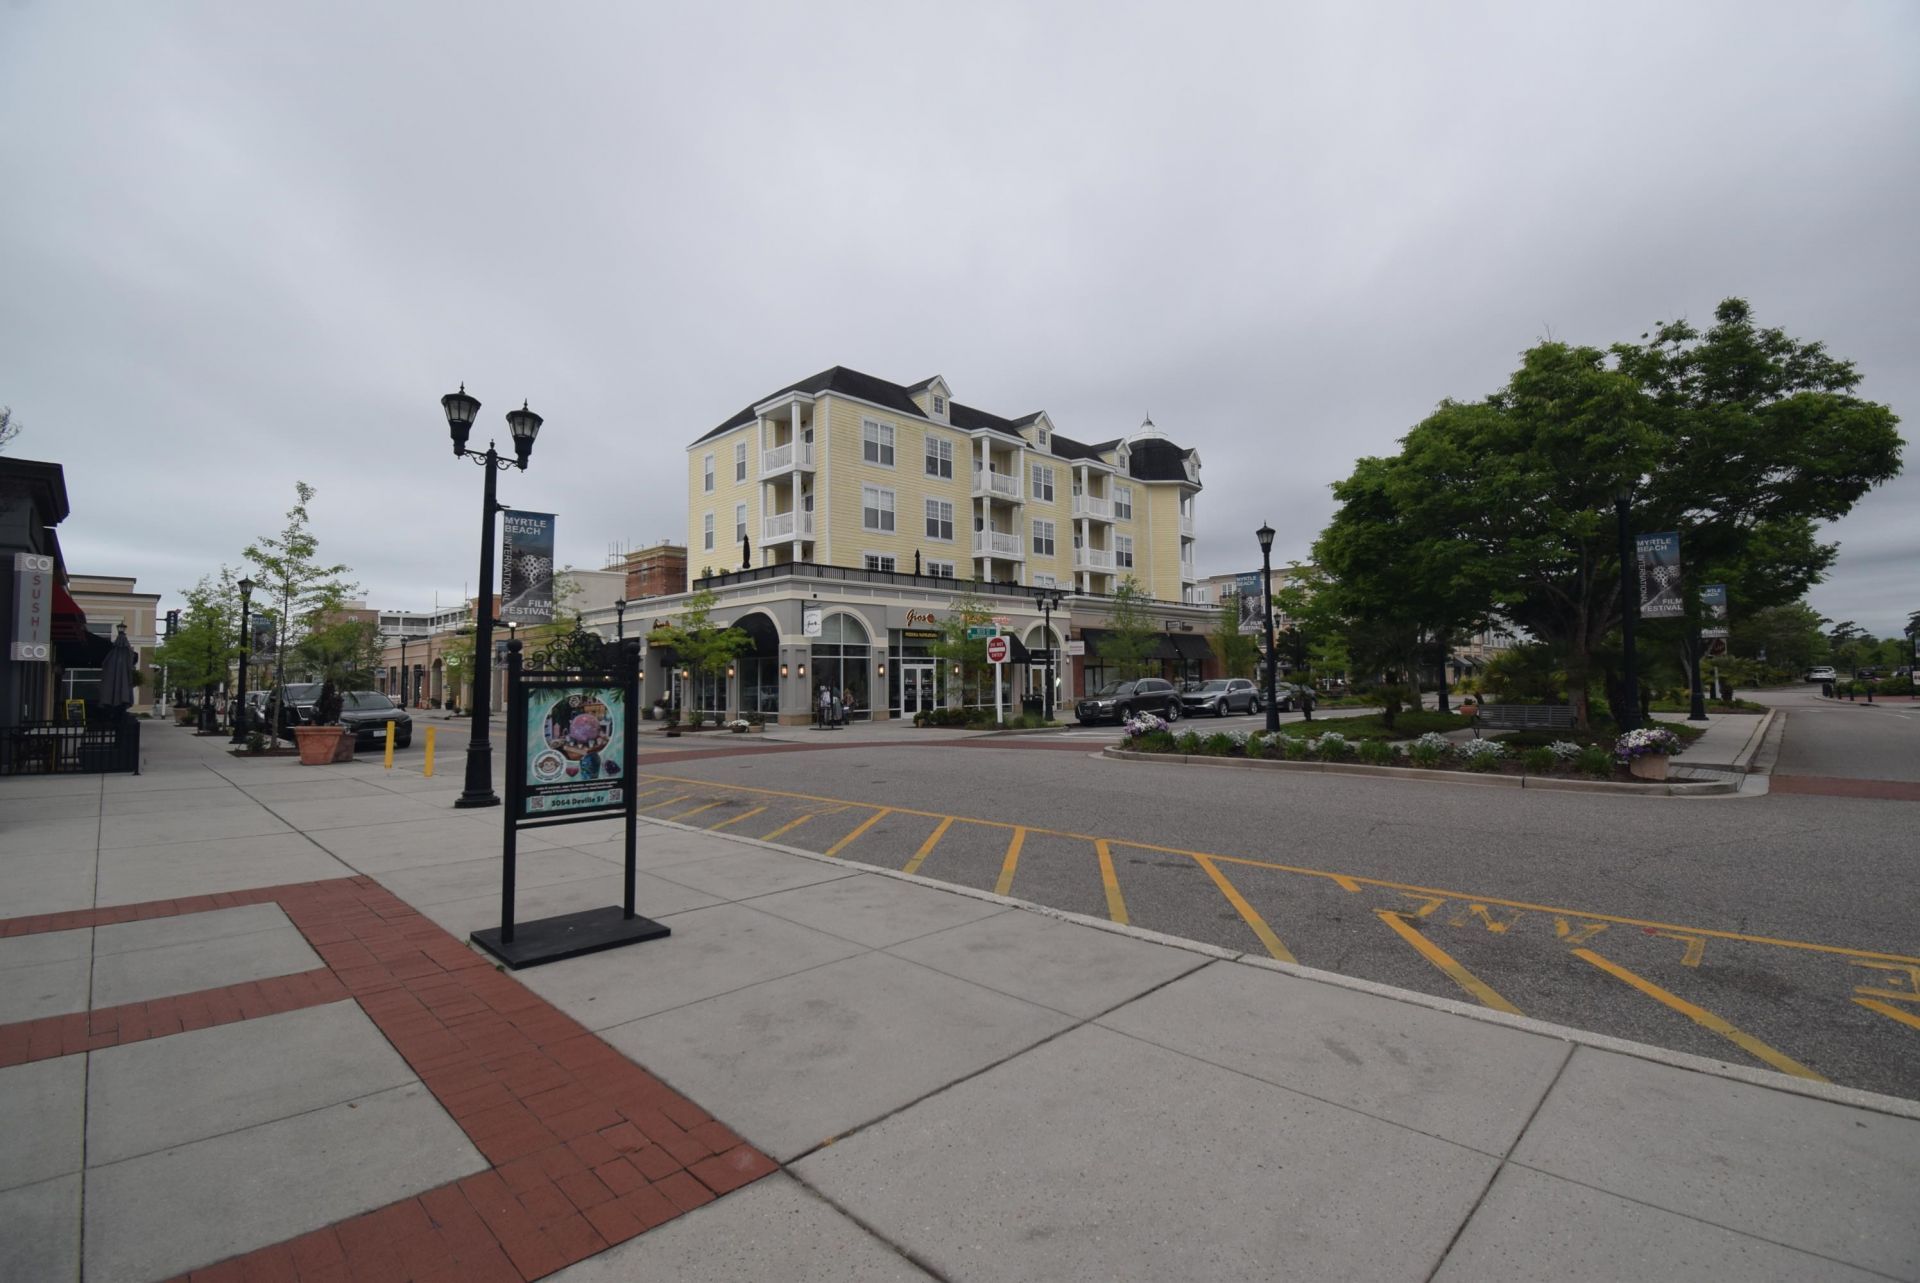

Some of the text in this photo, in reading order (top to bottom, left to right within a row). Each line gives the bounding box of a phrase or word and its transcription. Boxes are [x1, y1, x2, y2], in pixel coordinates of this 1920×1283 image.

[504, 516, 547, 528] MYRTLE
[504, 524, 542, 536] BEACH
[1637, 538, 1672, 547] MYRTLE
[1637, 545, 1668, 553] BEACH
[25, 556, 50, 571] CO
[503, 534, 513, 602] INTERNATIONAL
[31, 575, 42, 641] SUSHI
[528, 599, 553, 608] FILM
[1641, 604, 1684, 612] FESTIVAL
[503, 606, 552, 616] FESTIVAL
[22, 645, 47, 659] CO
